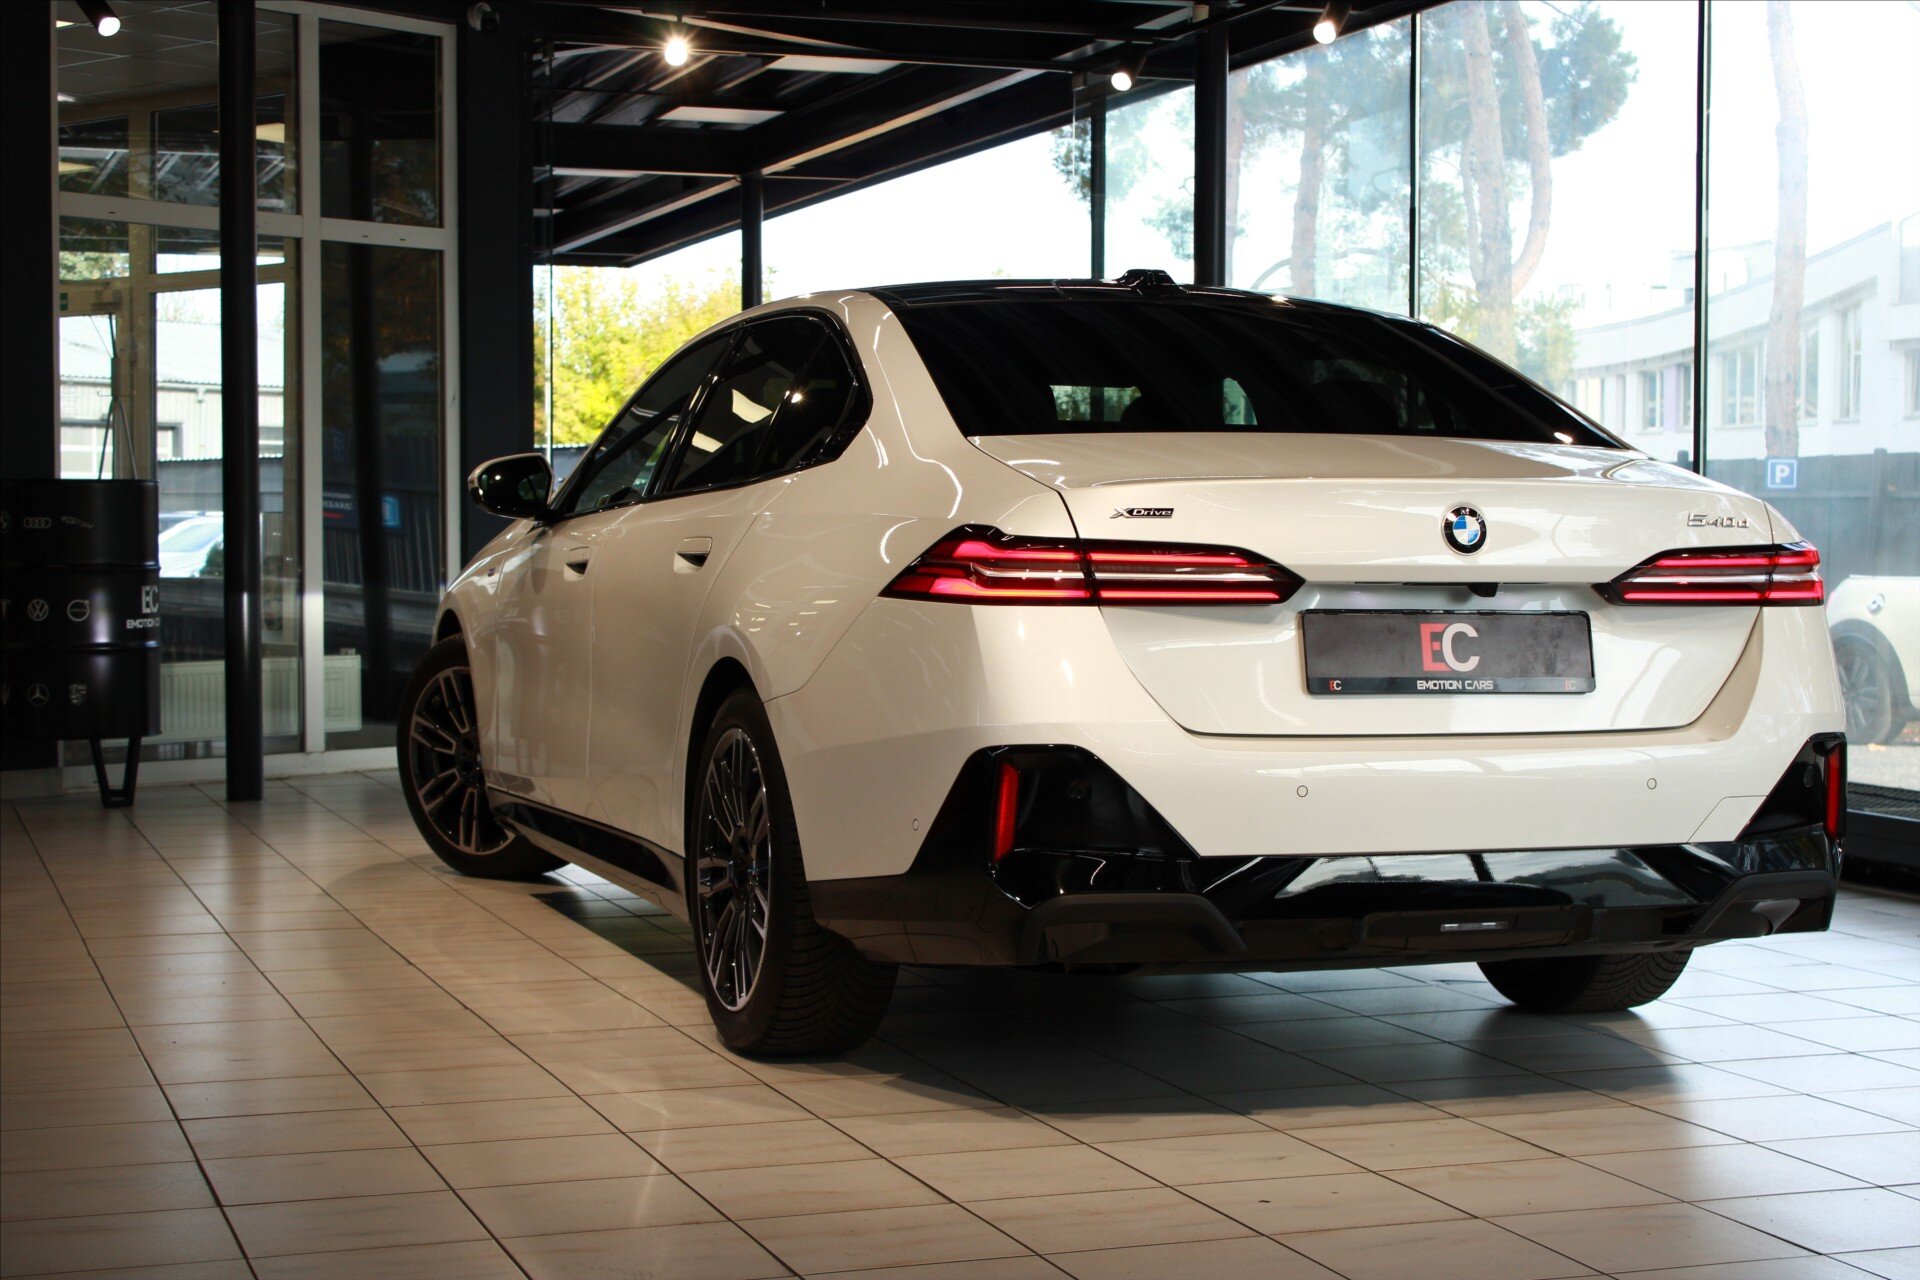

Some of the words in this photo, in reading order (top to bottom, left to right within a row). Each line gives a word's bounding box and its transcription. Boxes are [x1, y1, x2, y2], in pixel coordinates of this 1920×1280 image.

[1775, 464, 1790, 483] P
[1687, 513, 1749, 528] 540d
[141, 585, 159, 613] EC
[1420, 622, 1480, 672] EC
[1329, 680, 1342, 691] EC
[1416, 680, 1462, 690] EMOTION
[1464, 680, 1494, 690] CARS
